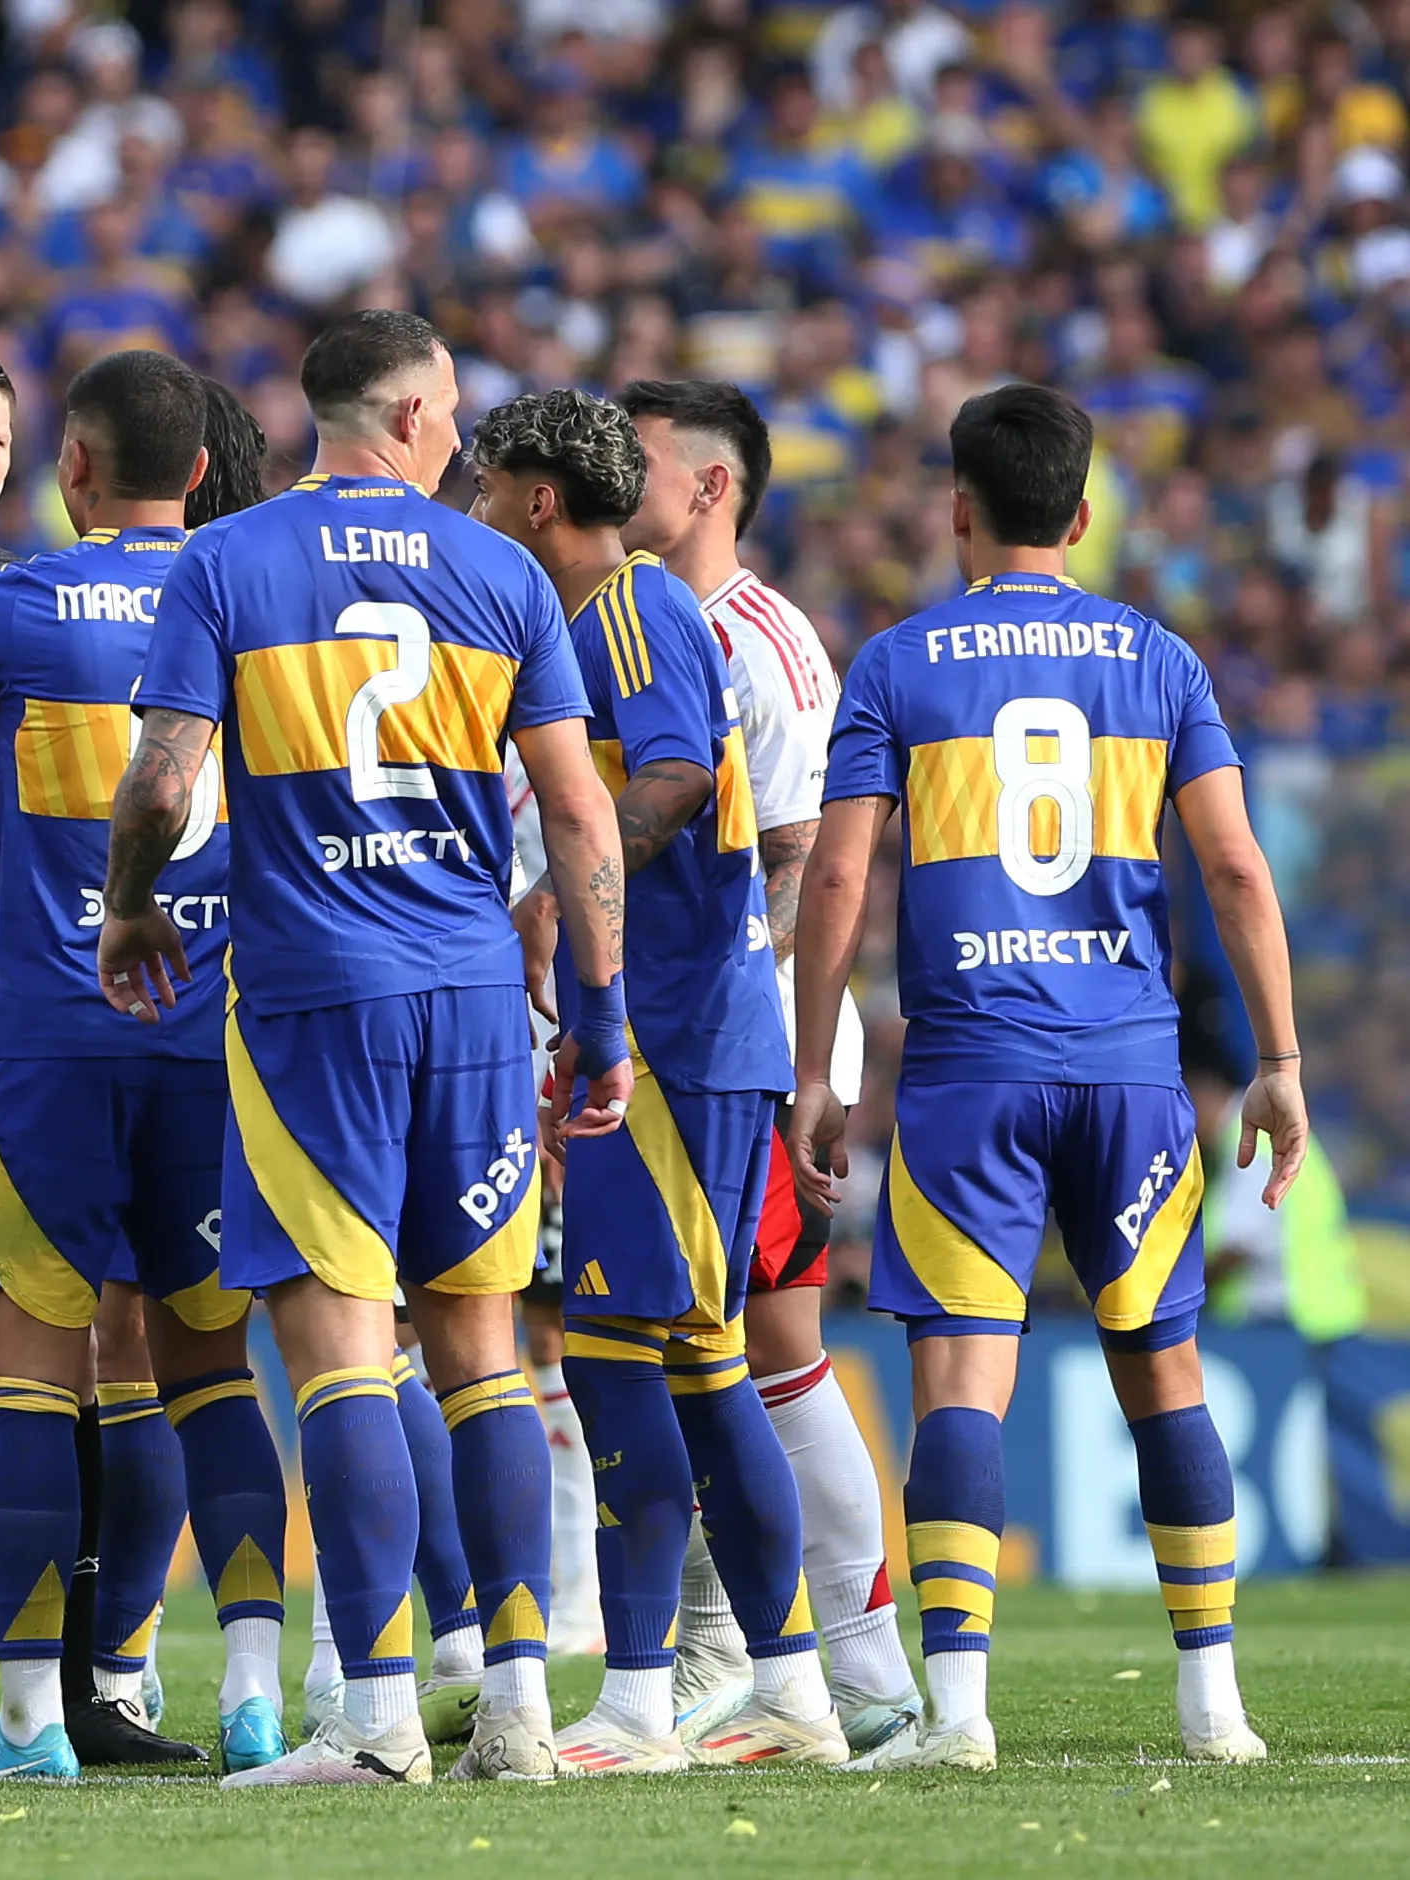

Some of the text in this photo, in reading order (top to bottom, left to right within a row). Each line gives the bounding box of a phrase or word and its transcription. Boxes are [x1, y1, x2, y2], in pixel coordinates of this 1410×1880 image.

[337, 487, 406, 499] XENEIZE
[123, 541, 182, 553] XENEIZ
[320, 526, 430, 569] LEMA
[992, 583, 1059, 595] XENEIZE
[926, 621, 1139, 664] FERNANDEZ
[334, 600, 439, 803] 2
[993, 697, 1094, 897] 8
[952, 929, 1131, 971] DIRECTV
[458, 1127, 533, 1231] pax
[1114, 1150, 1174, 1250] pax
